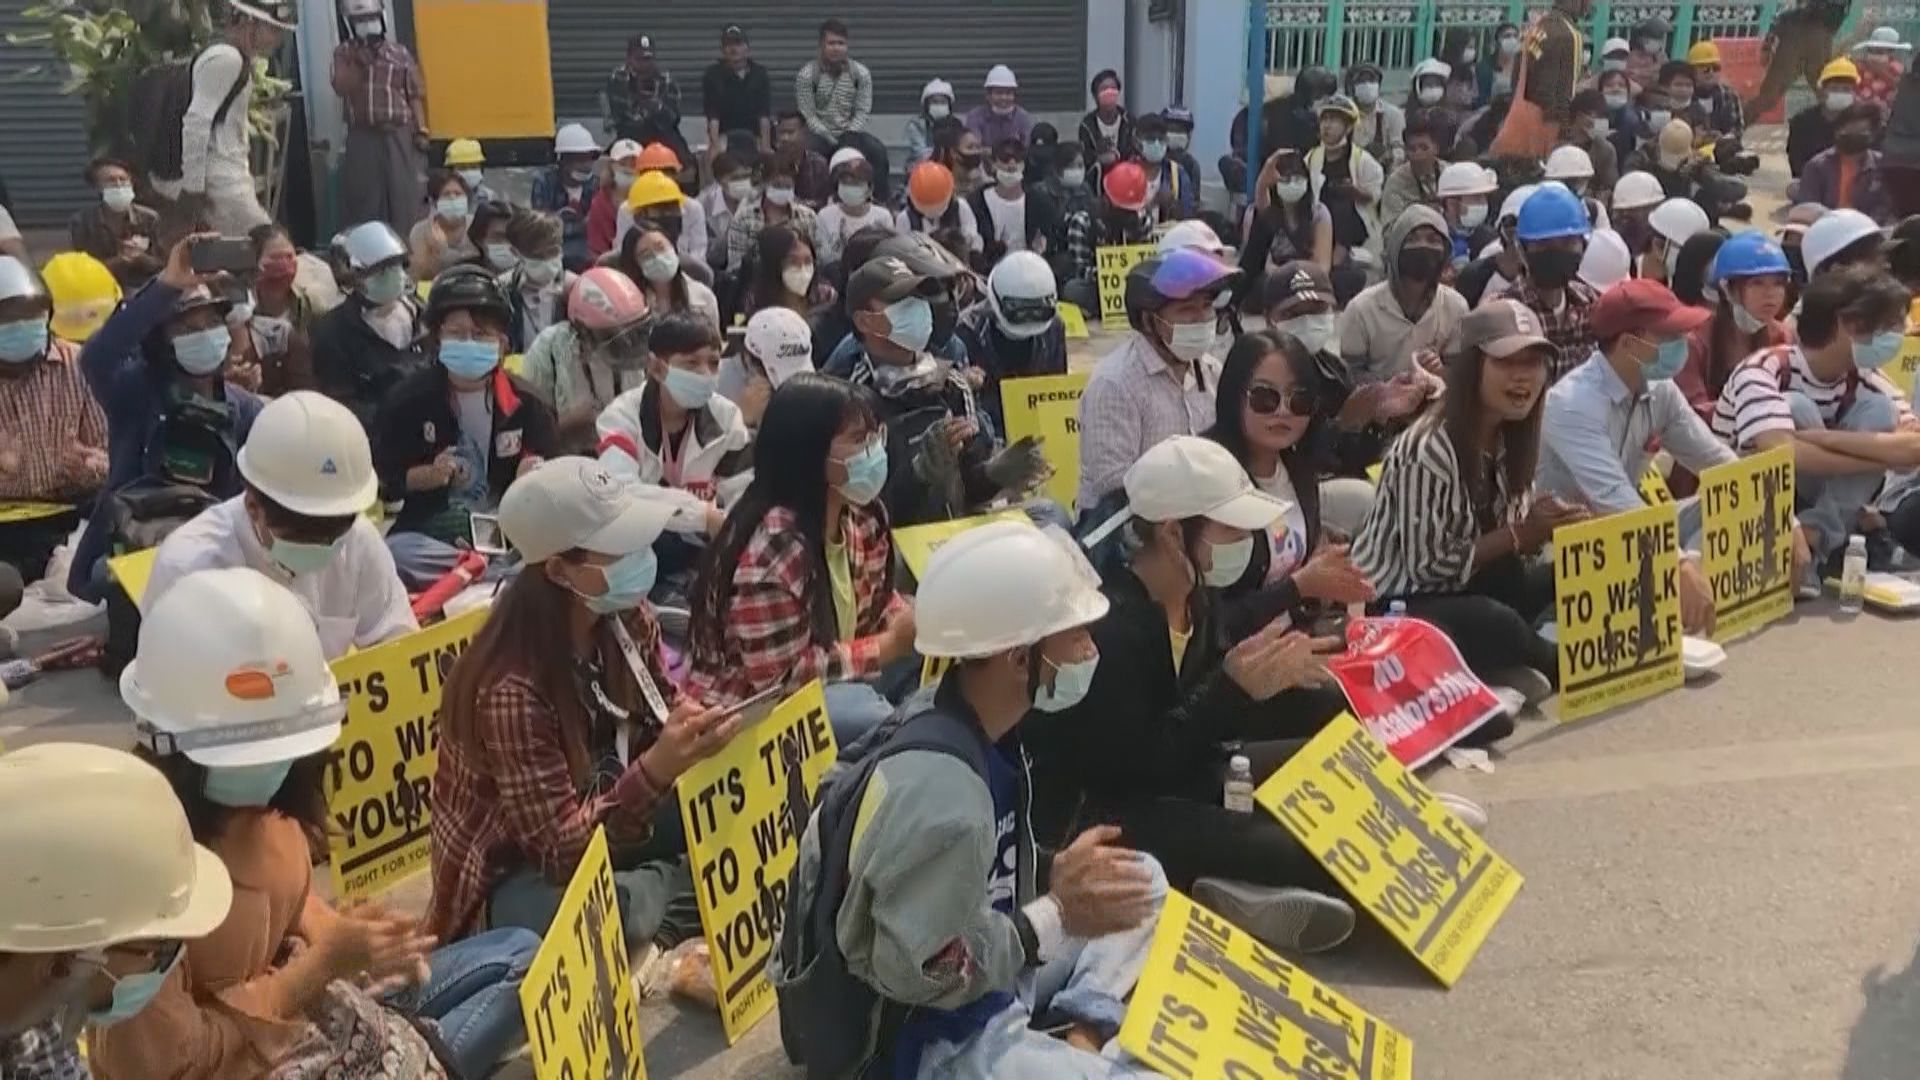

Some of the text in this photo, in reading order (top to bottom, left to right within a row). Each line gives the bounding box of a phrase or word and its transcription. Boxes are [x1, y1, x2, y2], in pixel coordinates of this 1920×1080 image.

[1101, 252, 1128, 269] IT'S
[1101, 273, 1120, 290] TO
[1706, 480, 1740, 517] IT'S
[1751, 463, 1791, 502] TIME
[1561, 522, 1675, 579] IT'S TIME
[1707, 505, 1792, 561] TO WAK
[1562, 567, 1678, 628] TO WAK
[1709, 549, 1790, 602] YOURSF
[336, 638, 469, 726] T'S TI
[1565, 614, 1678, 675] YOURSF
[330, 710, 441, 792] TO WA
[689, 706, 831, 844] IT'S TIME
[1278, 779, 1336, 838] IT'S
[1321, 730, 1388, 791] TIME
[335, 775, 433, 849] YOUR
[1323, 771, 1433, 886] TO WAK
[381, 855, 407, 877] FOR
[409, 844, 432, 866] YOU
[701, 802, 797, 911] TO WA
[1373, 816, 1473, 931] YOURSF
[534, 955, 572, 1064] IT'S
[573, 856, 613, 967] TIME
[715, 876, 787, 974] YOUR
[577, 925, 627, 1068] WAK
[756, 978, 772, 999] FO
[1146, 905, 1231, 1080] IT'S TIME
[1234, 942, 1293, 1053] WAK
